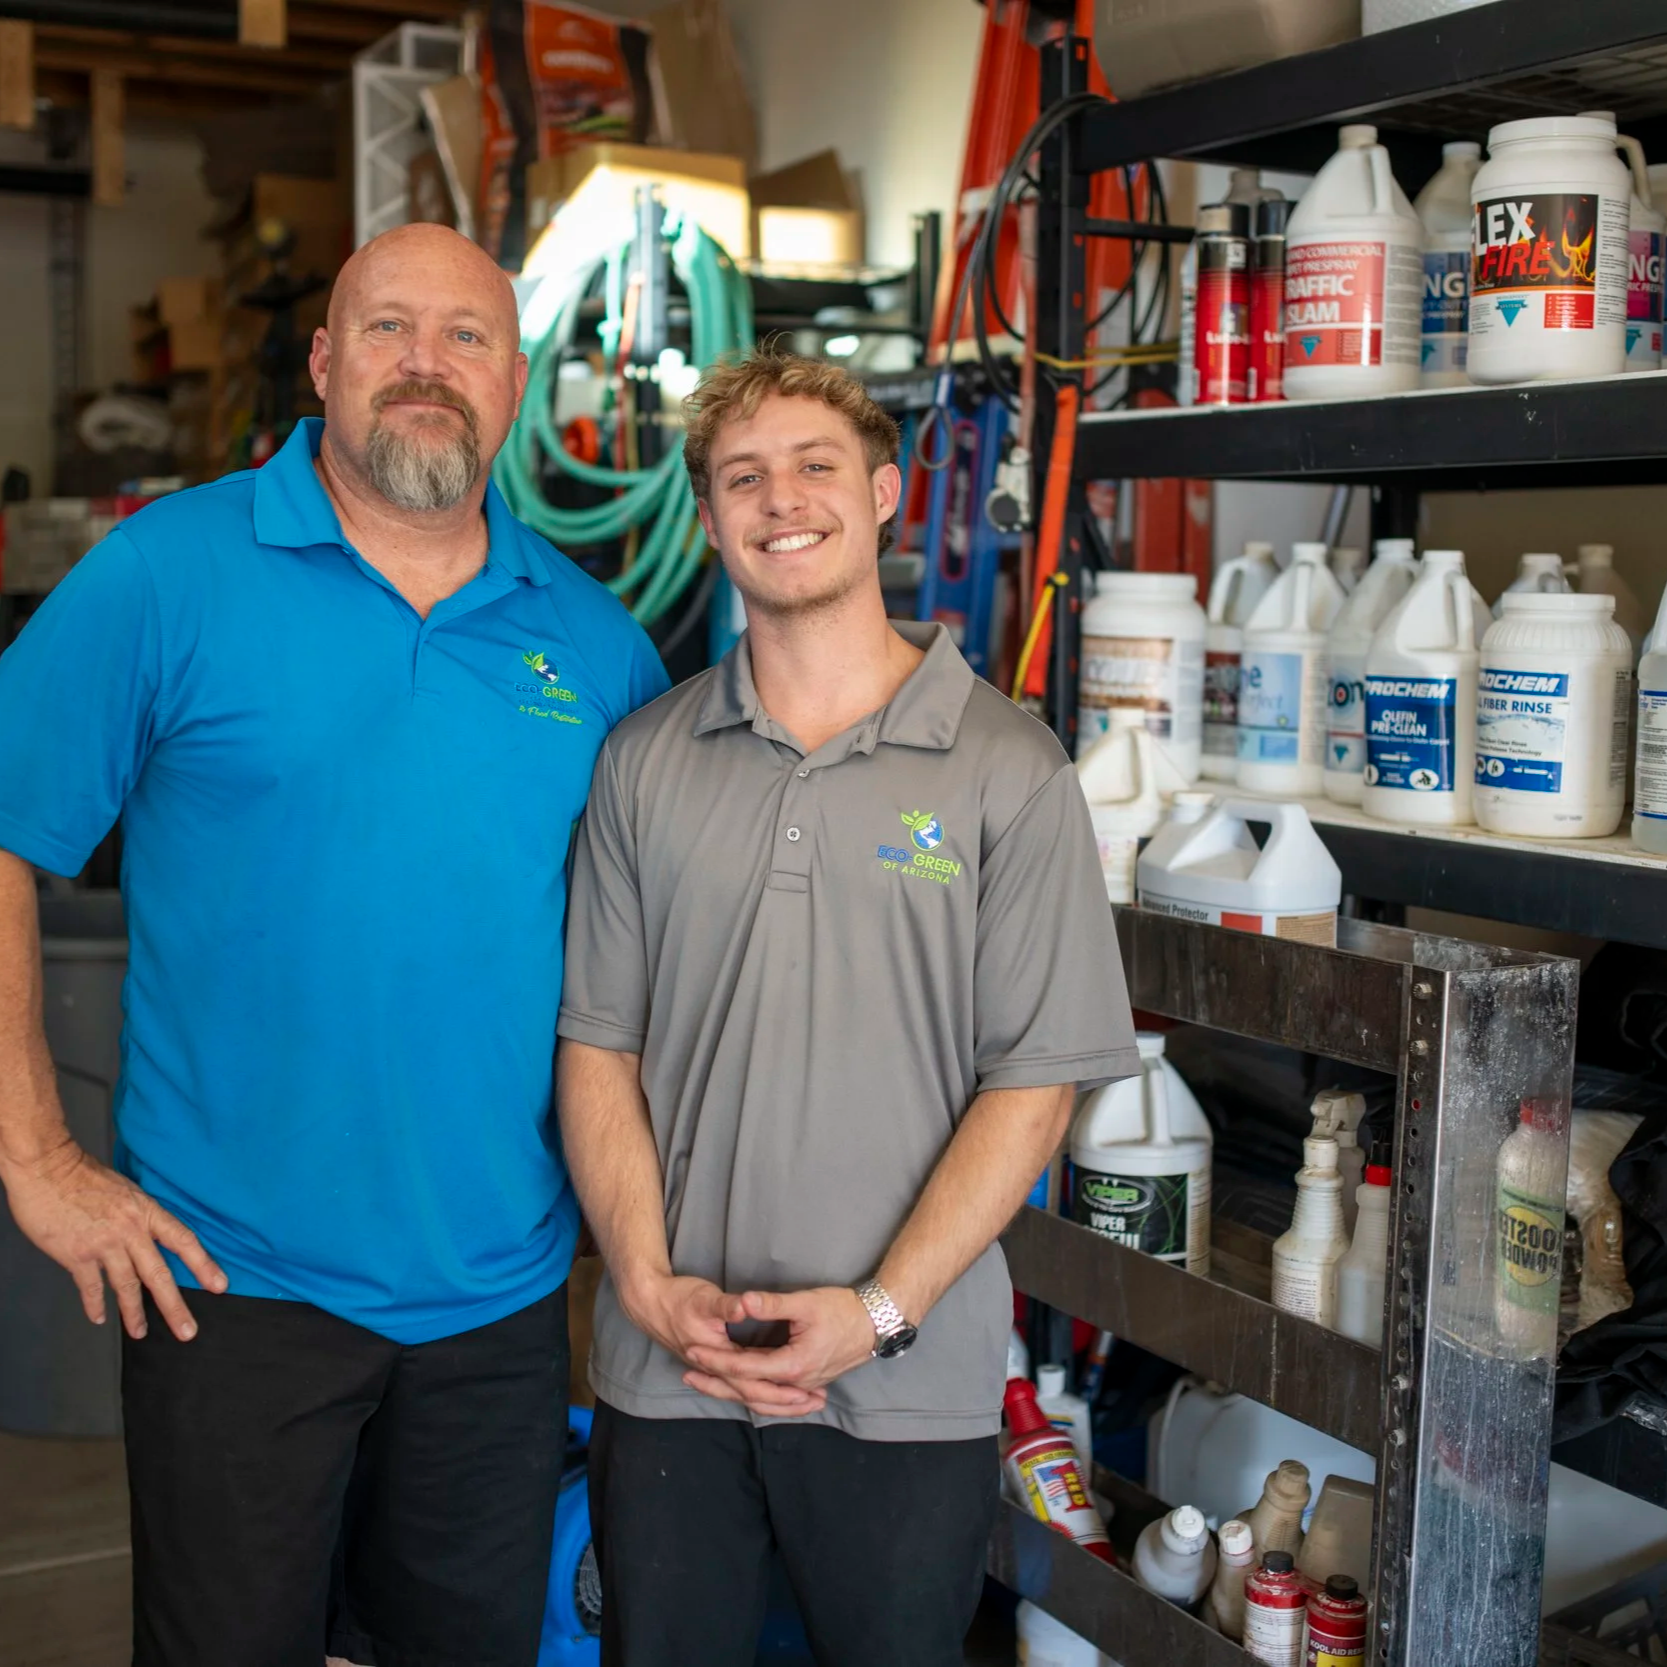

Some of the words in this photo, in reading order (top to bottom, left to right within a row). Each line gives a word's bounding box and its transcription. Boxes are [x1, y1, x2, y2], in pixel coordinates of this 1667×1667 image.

[1307, 244, 1382, 259] COMMERCIAL
[1482, 240, 1555, 279] FIRE
[1287, 301, 1341, 325] SLAM
[1484, 697, 1507, 711] FIBER
[1511, 701, 1552, 714] RINSE
[1382, 709, 1417, 725] OLEFIN
[1371, 720, 1427, 737] PRE-CLEAN
[878, 845, 961, 876] ECO-GREEN
[883, 861, 898, 871] OF
[901, 865, 950, 884] ARIZONA
[1172, 904, 1209, 921] Protector
[1091, 1211, 1126, 1231] VIPER
[1310, 1639, 1330, 1653] KOOL
[1331, 1647, 1347, 1656] AID
